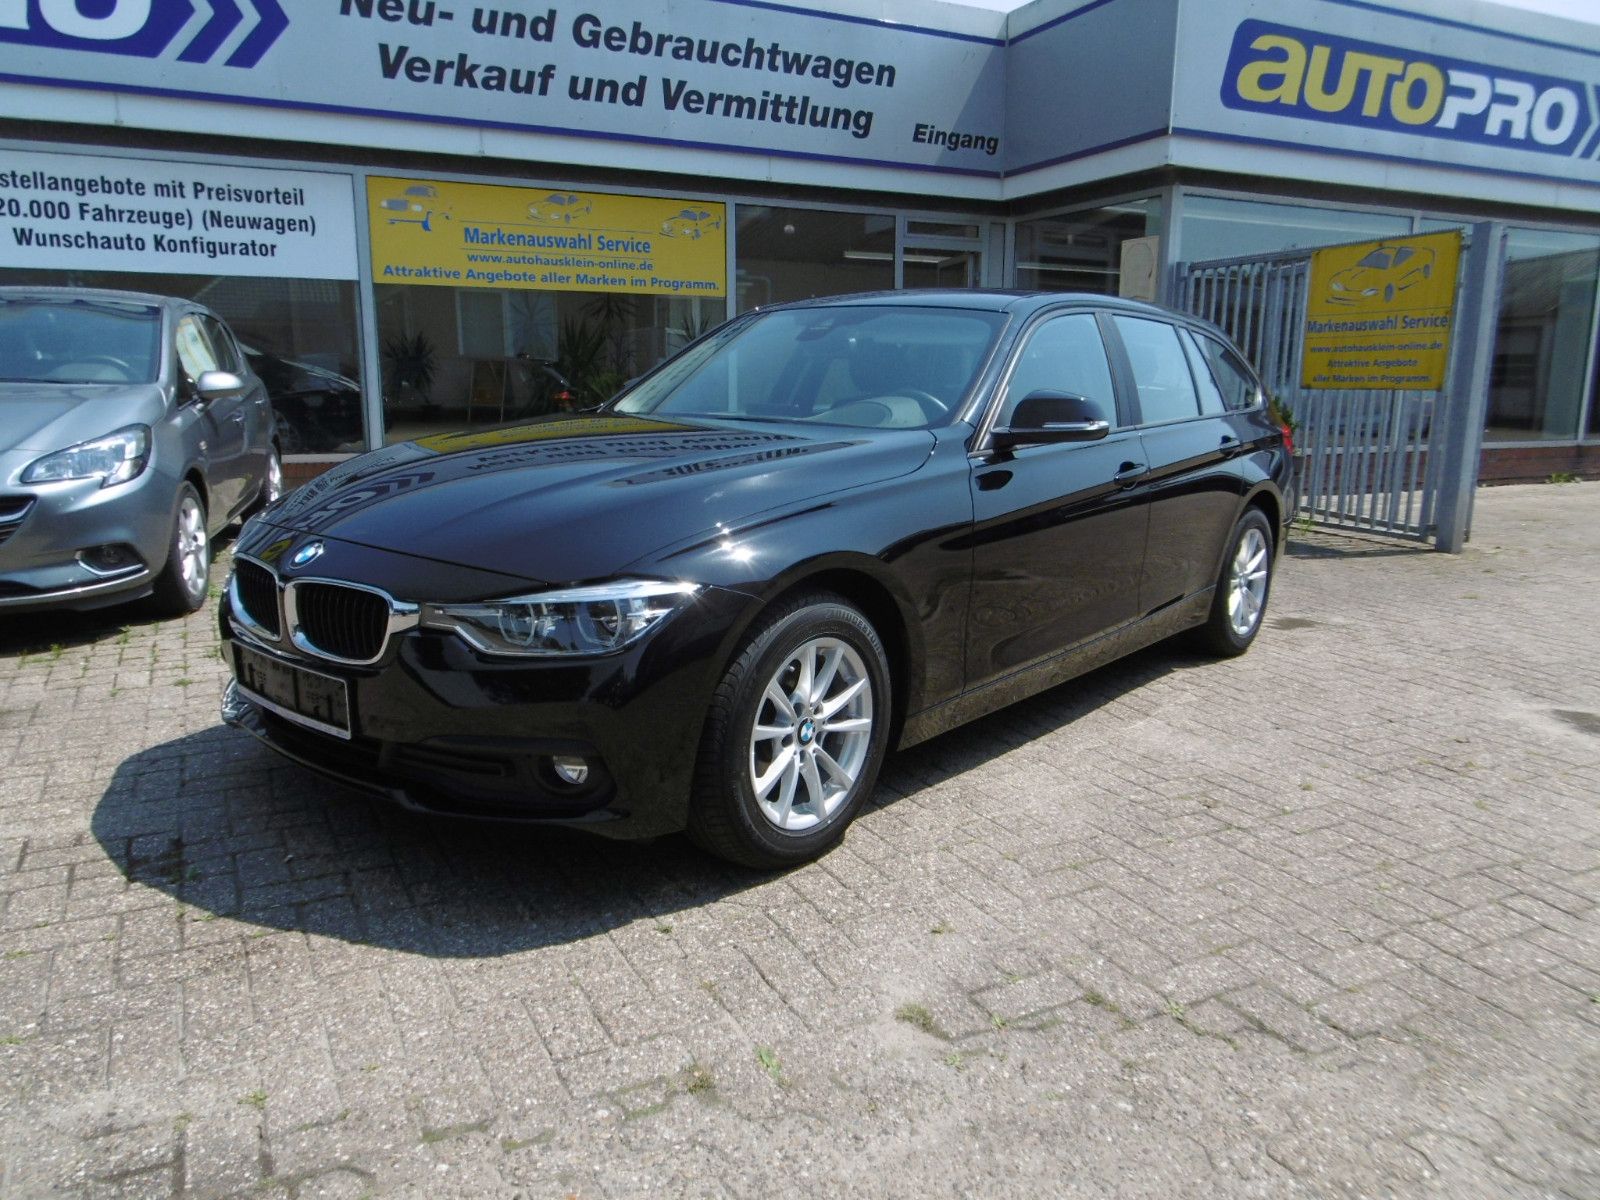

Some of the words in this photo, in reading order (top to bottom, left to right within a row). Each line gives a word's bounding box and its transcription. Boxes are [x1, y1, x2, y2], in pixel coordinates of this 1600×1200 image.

[471, 8, 557, 43] und
[572, 13, 896, 89] Gebrauchtwagen
[378, 42, 556, 97] Verkauf
[568, 75, 647, 107] und
[661, 77, 874, 139] Vermittlung
[912, 123, 999, 155] Eingang
[154, 180, 186, 198] mit
[193, 181, 304, 206] Preisvorteil
[79, 202, 193, 231] Fahrzeuge)
[202, 209, 316, 237] (Neuwagen)
[12, 227, 146, 251] Wunschauto
[153, 234, 277, 259] Konfigurator
[464, 227, 592, 250] Markenauswahl
[597, 235, 651, 253] Service
[467, 253, 653, 271] www.autohausklein-online.de
[383, 264, 461, 280] Attraktive
[466, 269, 536, 283] Angebote
[541, 272, 571, 284] aller
[576, 274, 627, 287] Marken
[631, 277, 647, 287] im
[651, 277, 719, 291] Programm.
[1307, 315, 1398, 333] Markenauswahl
[1402, 313, 1449, 329] Service
